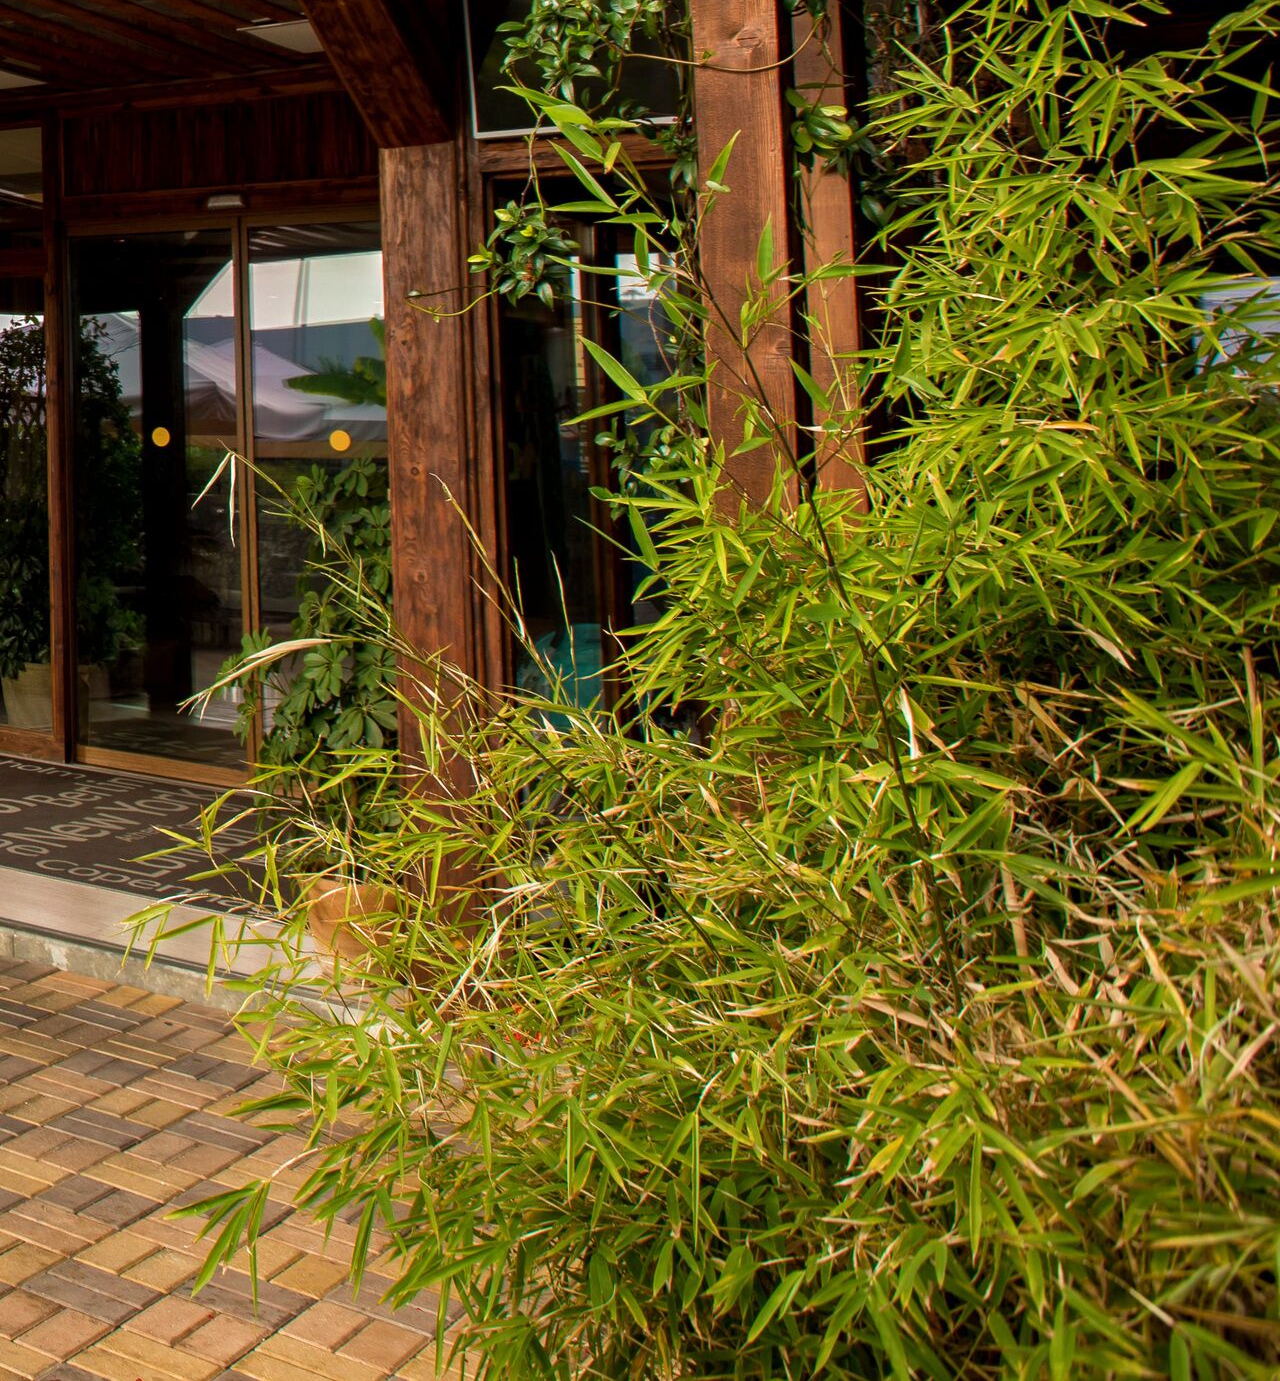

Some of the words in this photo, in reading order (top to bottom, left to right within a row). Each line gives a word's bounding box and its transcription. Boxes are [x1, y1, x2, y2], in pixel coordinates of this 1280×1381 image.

[22, 776, 155, 809] Berlin
[1, 812, 142, 849] New
[93, 788, 224, 817] York
